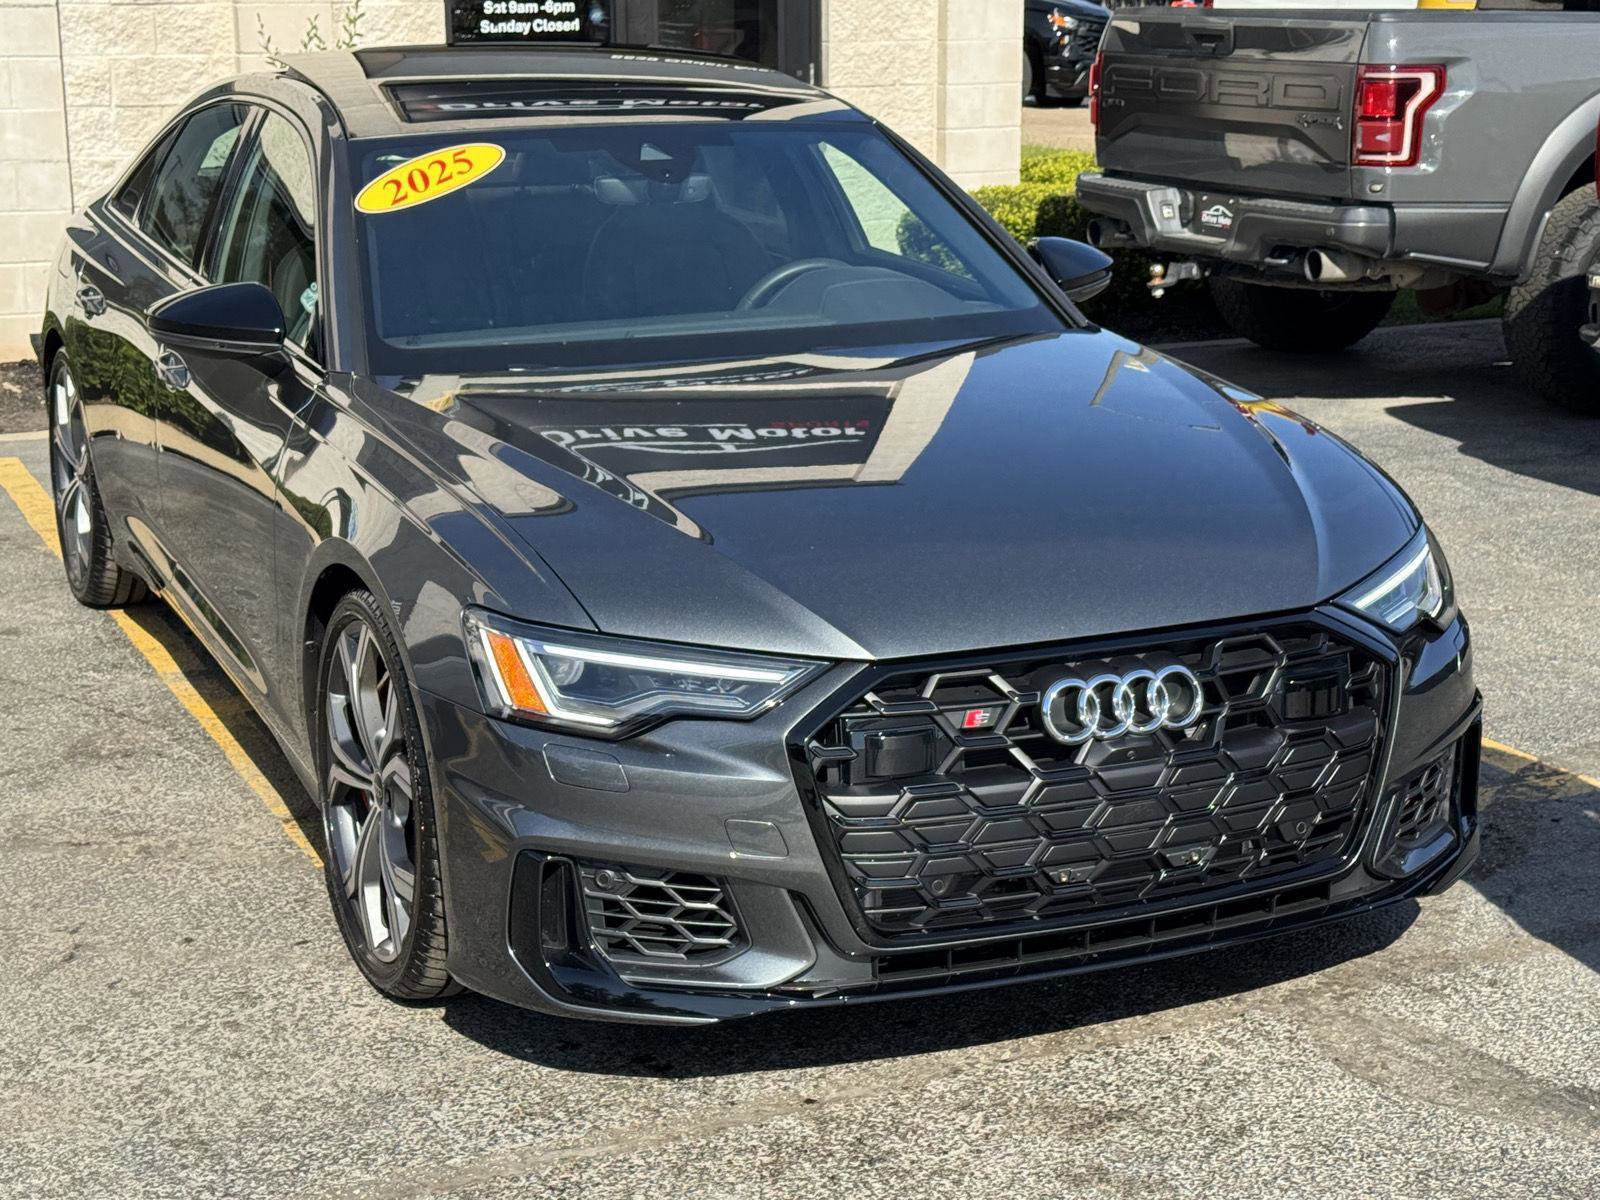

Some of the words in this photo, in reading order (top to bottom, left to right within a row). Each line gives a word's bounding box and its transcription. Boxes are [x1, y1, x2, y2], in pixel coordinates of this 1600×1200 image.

[483, 1, 507, 14] Sat
[508, 1, 538, 14] 9am
[480, 19, 531, 35] Sunday
[532, 18, 580, 32] Closed
[1102, 64, 1342, 112] FORD
[383, 149, 474, 206] 2025
